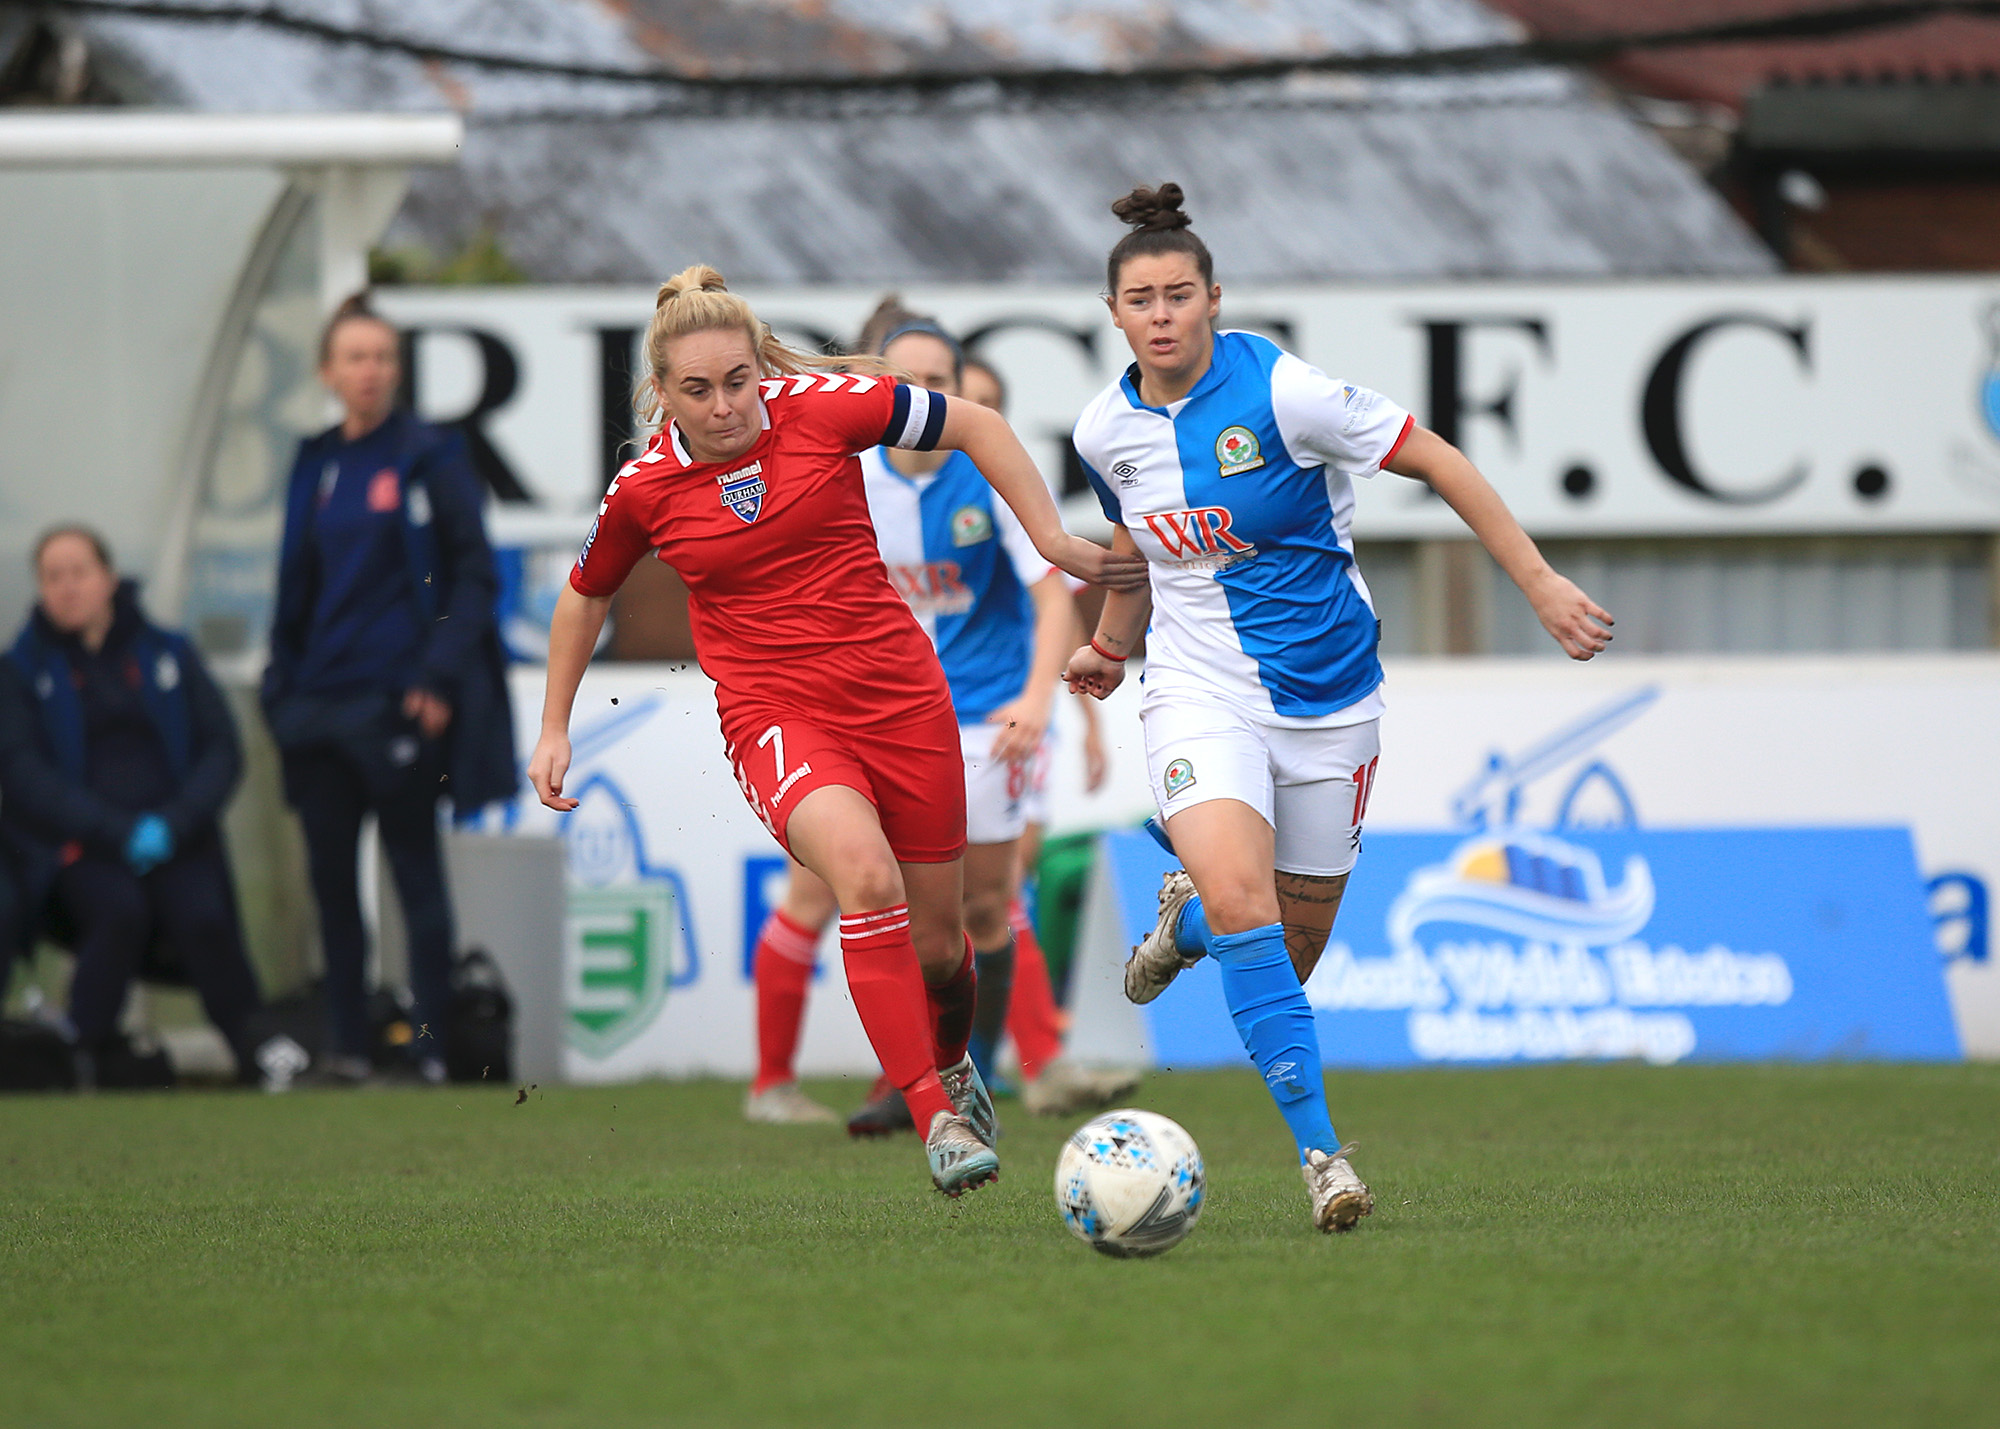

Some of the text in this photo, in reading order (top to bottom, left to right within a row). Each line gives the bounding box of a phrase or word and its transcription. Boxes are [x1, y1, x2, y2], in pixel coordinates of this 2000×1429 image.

[722, 483, 766, 505] DURHAM
[1142, 506, 1256, 560] WR
[757, 725, 786, 782] 7
[770, 761, 813, 808] hummel
